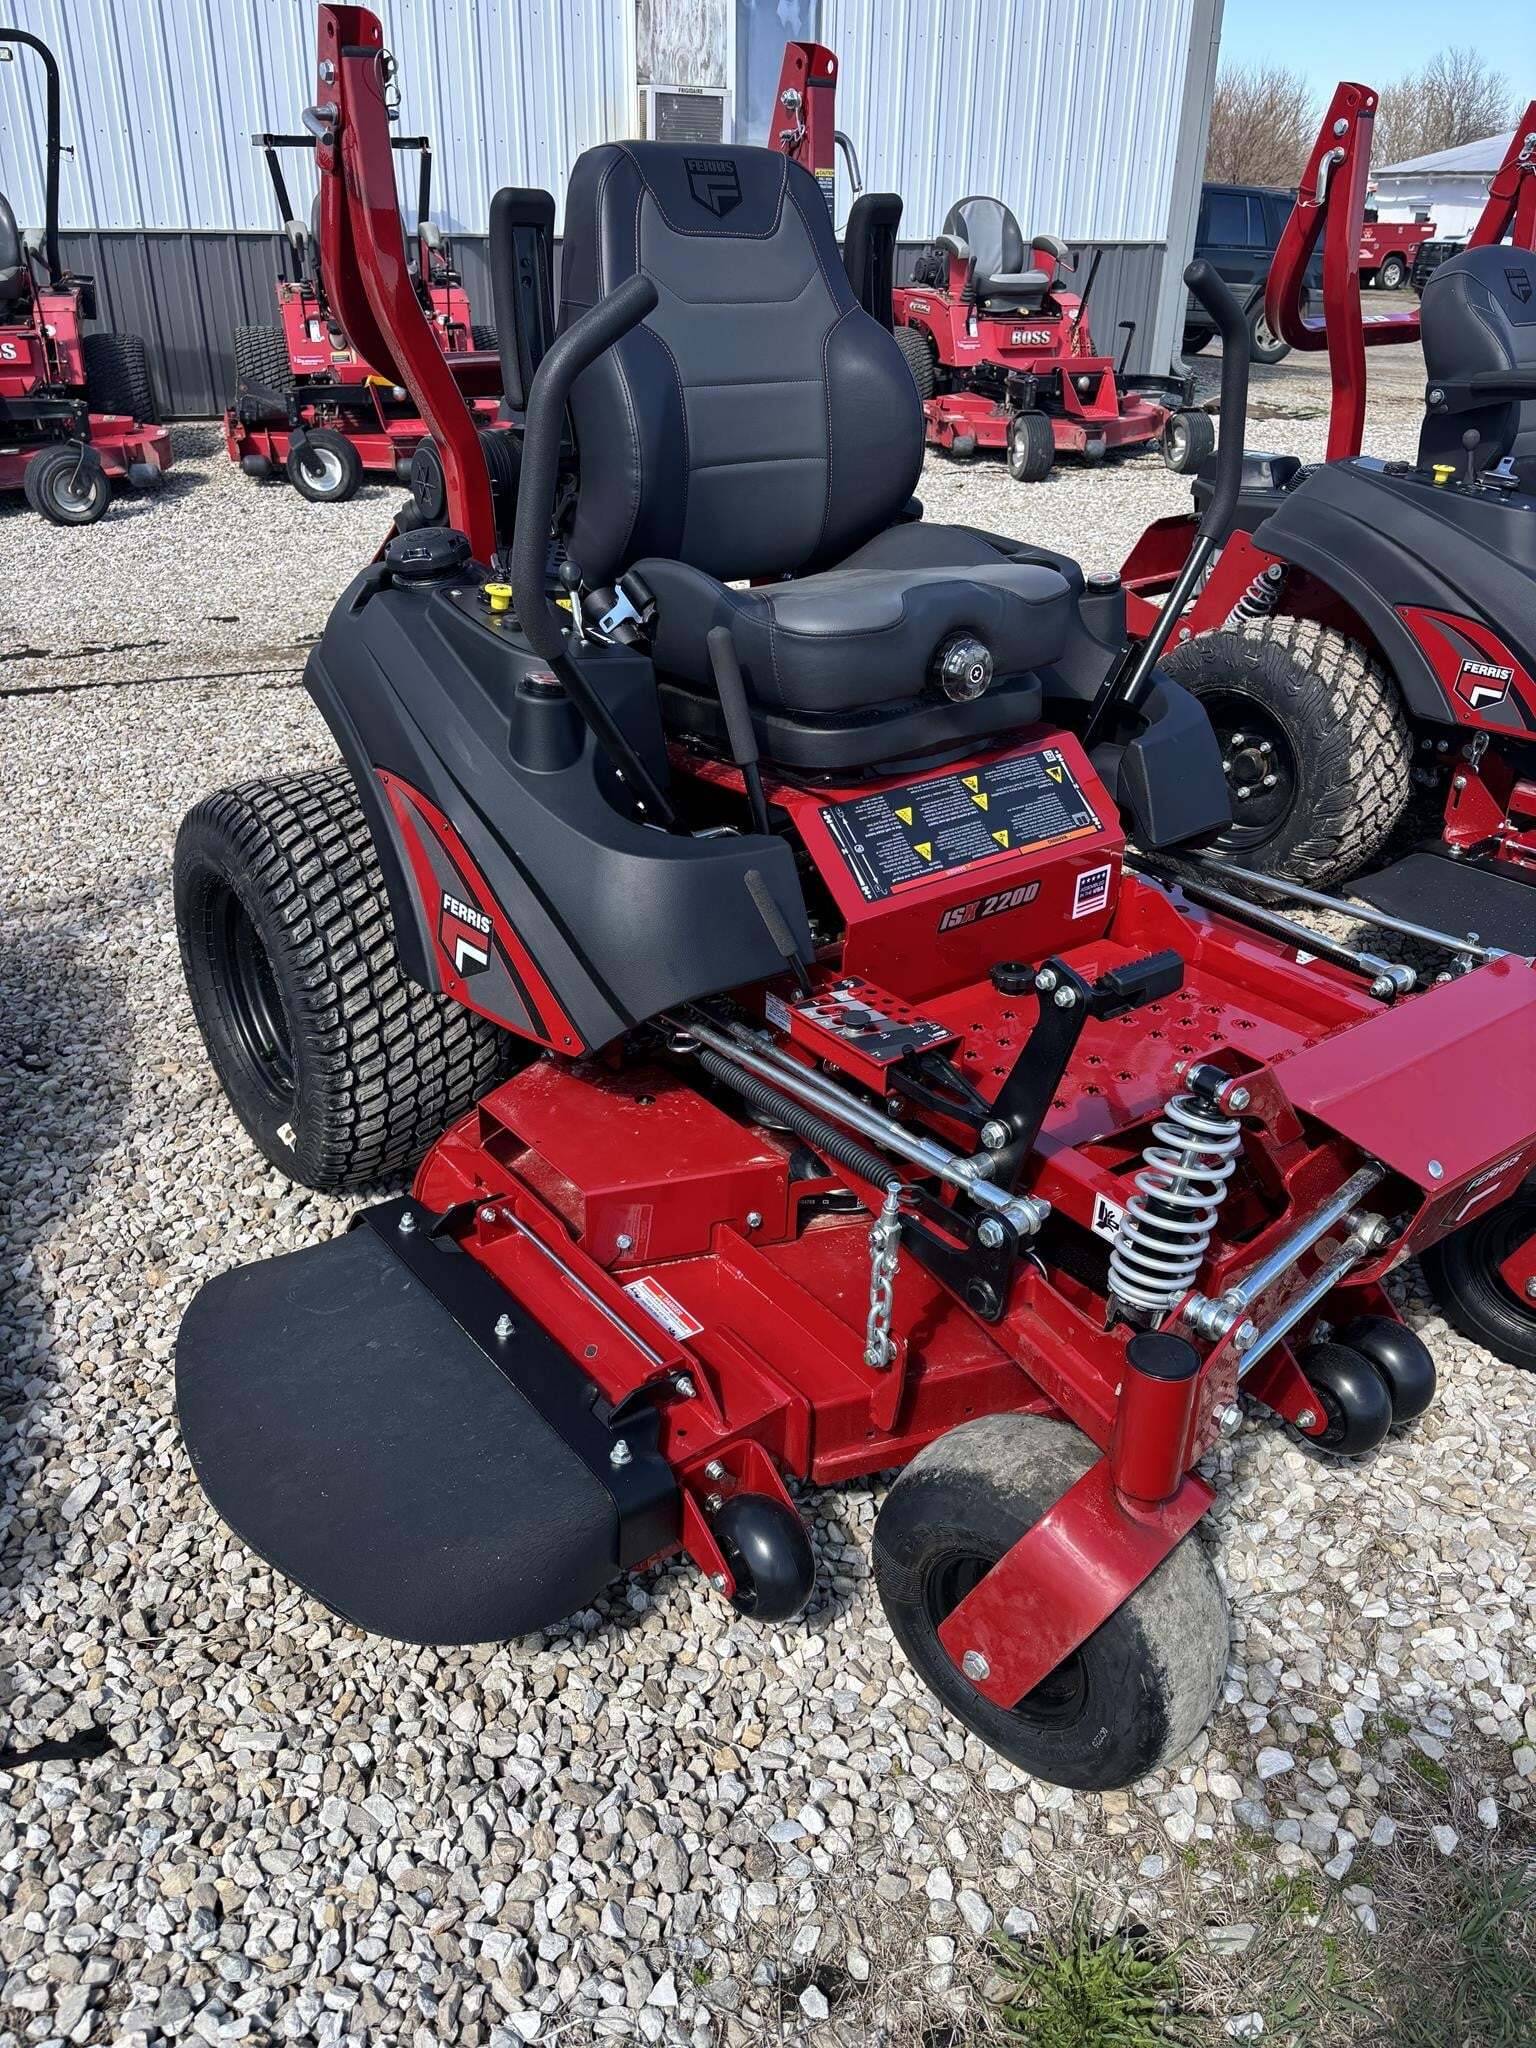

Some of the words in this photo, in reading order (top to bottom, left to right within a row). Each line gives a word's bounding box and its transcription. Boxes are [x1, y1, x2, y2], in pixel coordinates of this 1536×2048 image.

[688, 160, 735, 173] FERRIS
[1011, 330, 1051, 346] BOSS
[0, 342, 17, 360] S
[1463, 661, 1509, 680] FERRIS
[443, 893, 491, 934] FERRIS
[939, 901, 980, 931] ISX
[982, 882, 1040, 917] 2200
[1466, 1152, 1524, 1193] FERRIS
[663, 1297, 683, 1316] DANGER
